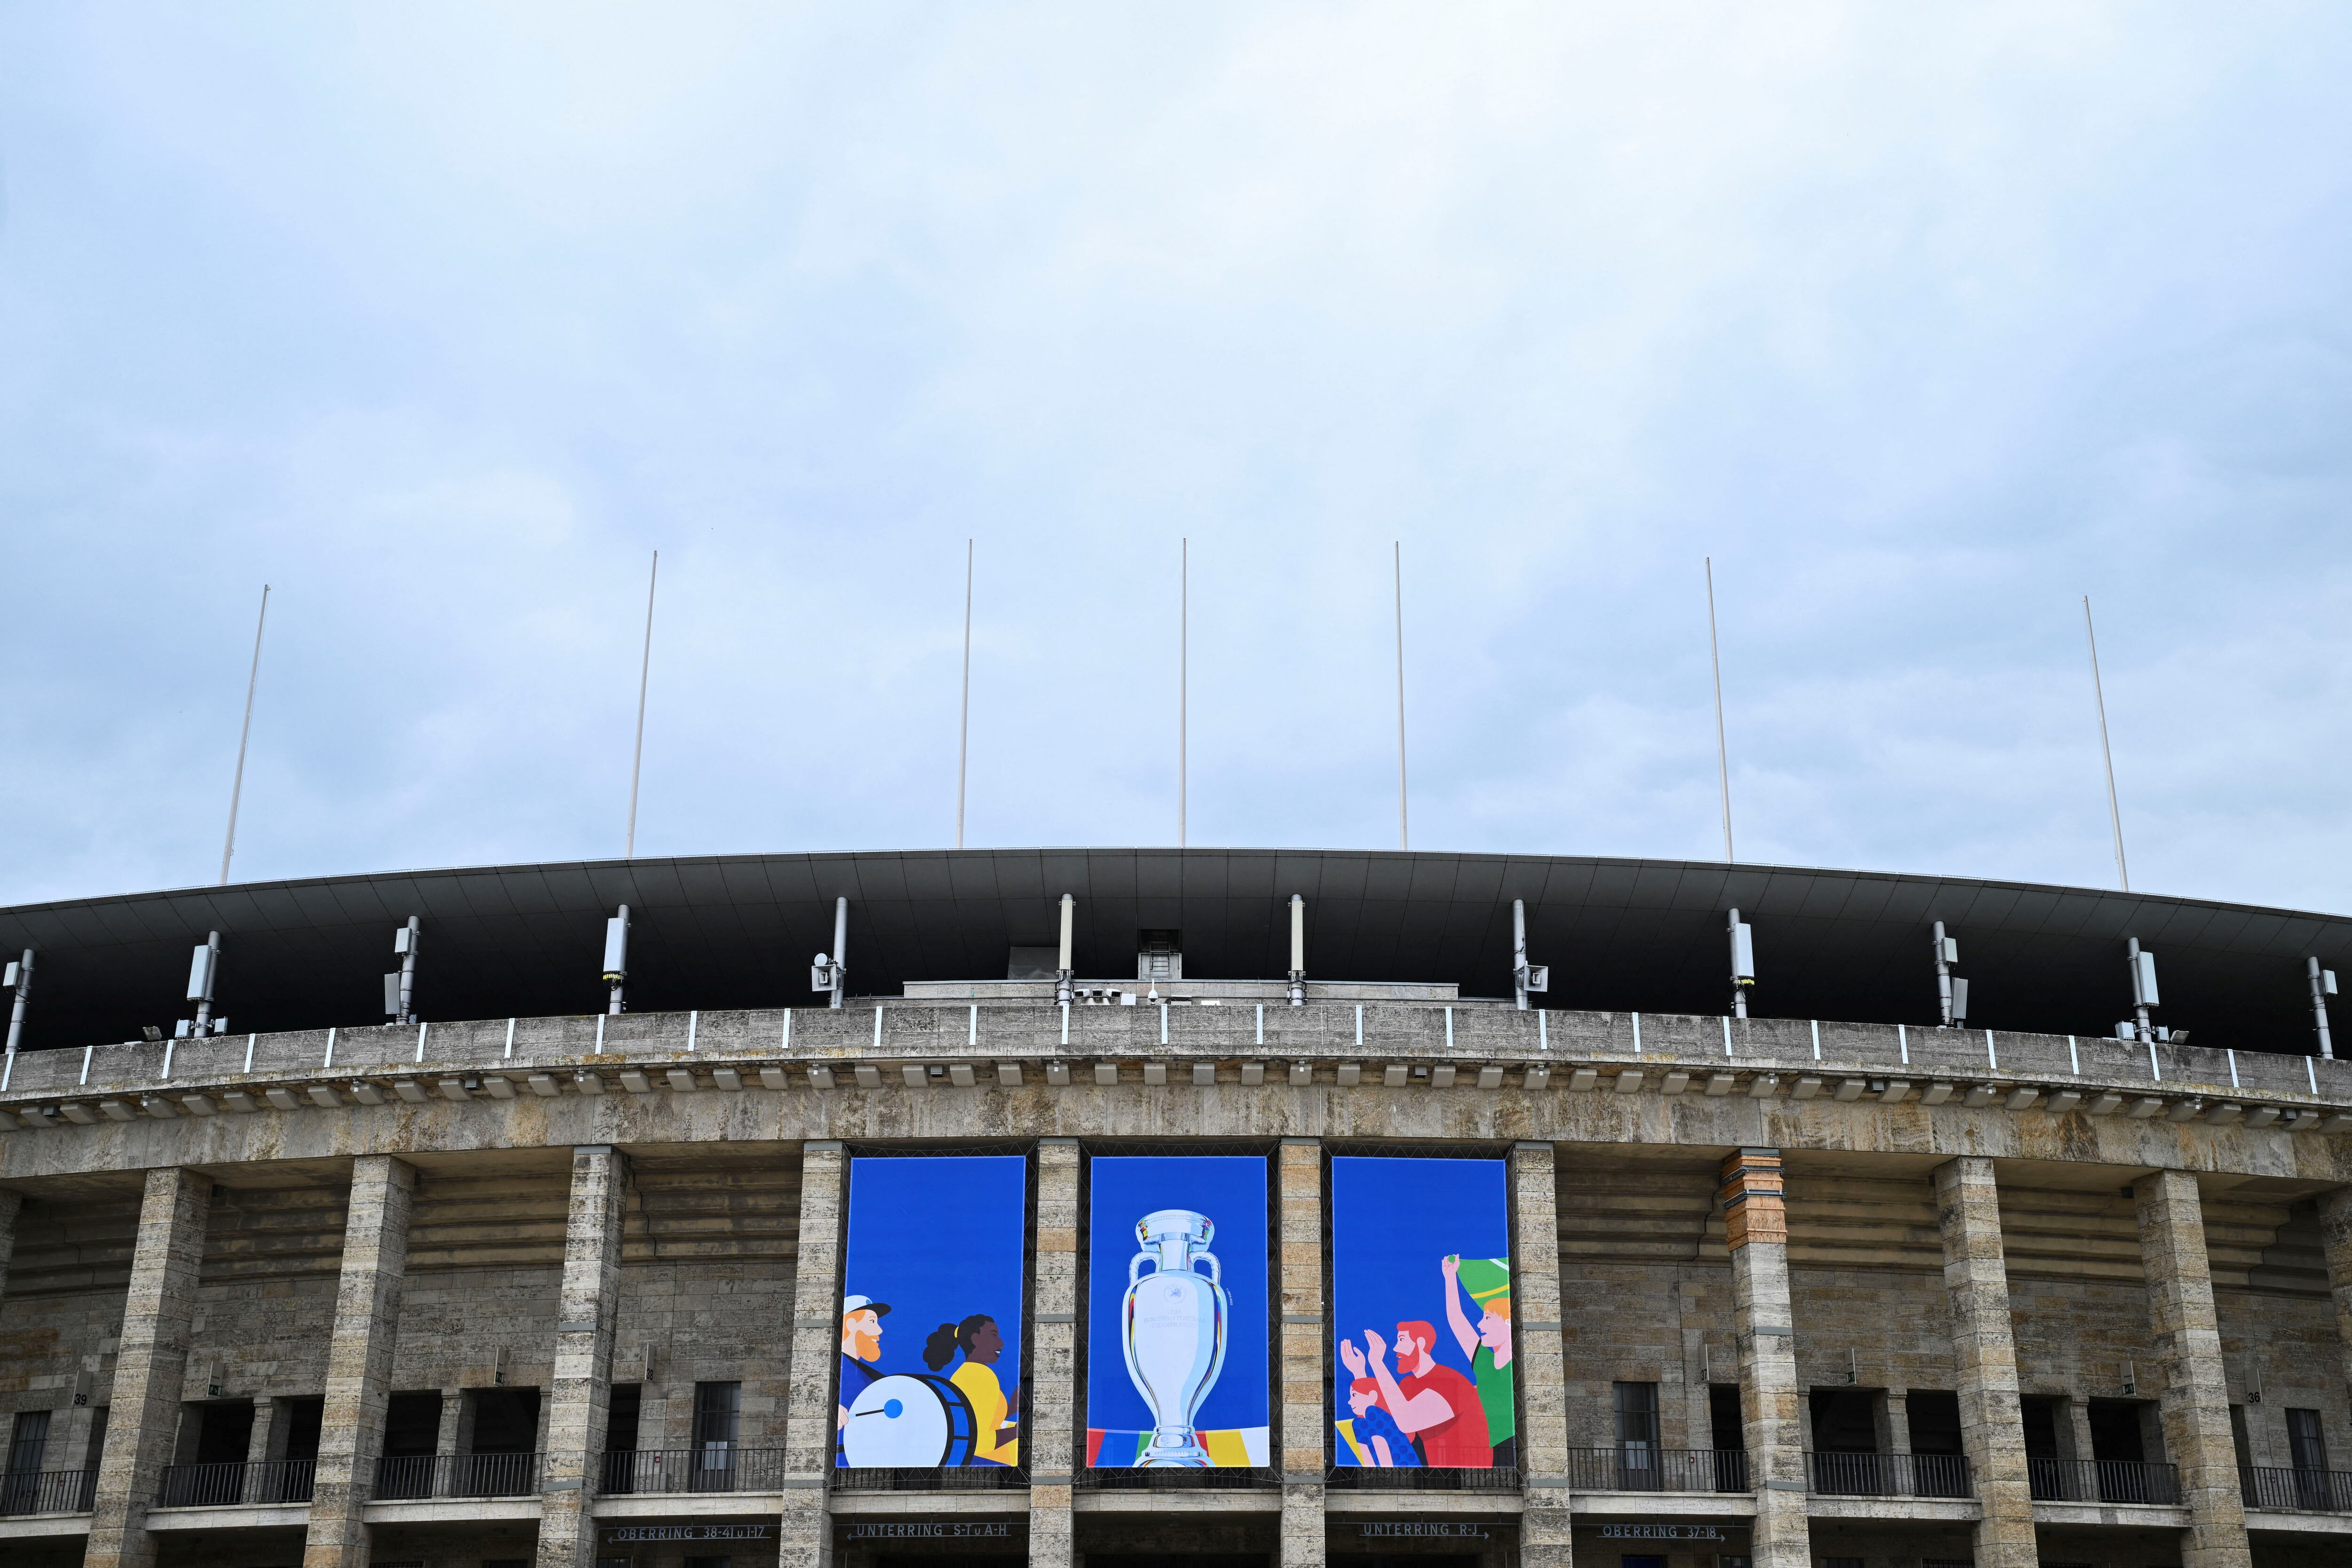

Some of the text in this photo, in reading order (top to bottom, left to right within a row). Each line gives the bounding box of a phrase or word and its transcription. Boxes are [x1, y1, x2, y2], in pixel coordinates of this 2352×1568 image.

[647, 1368, 653, 1380] 38
[1701, 1369, 1707, 1381] 37
[75, 1393, 87, 1405] 39
[2249, 1392, 2260, 1403] 36
[618, 1527, 692, 1539] OBERRING
[703, 1527, 734, 1538] 38-41
[747, 1526, 764, 1537] 1-17
[857, 1525, 942, 1536] UNTERRING
[954, 1524, 972, 1536] S-T
[984, 1524, 1007, 1536] A-H
[1364, 1524, 1477, 1535] UNTERRING R-J
[1603, 1526, 1716, 1537] OBERRING 37-18
